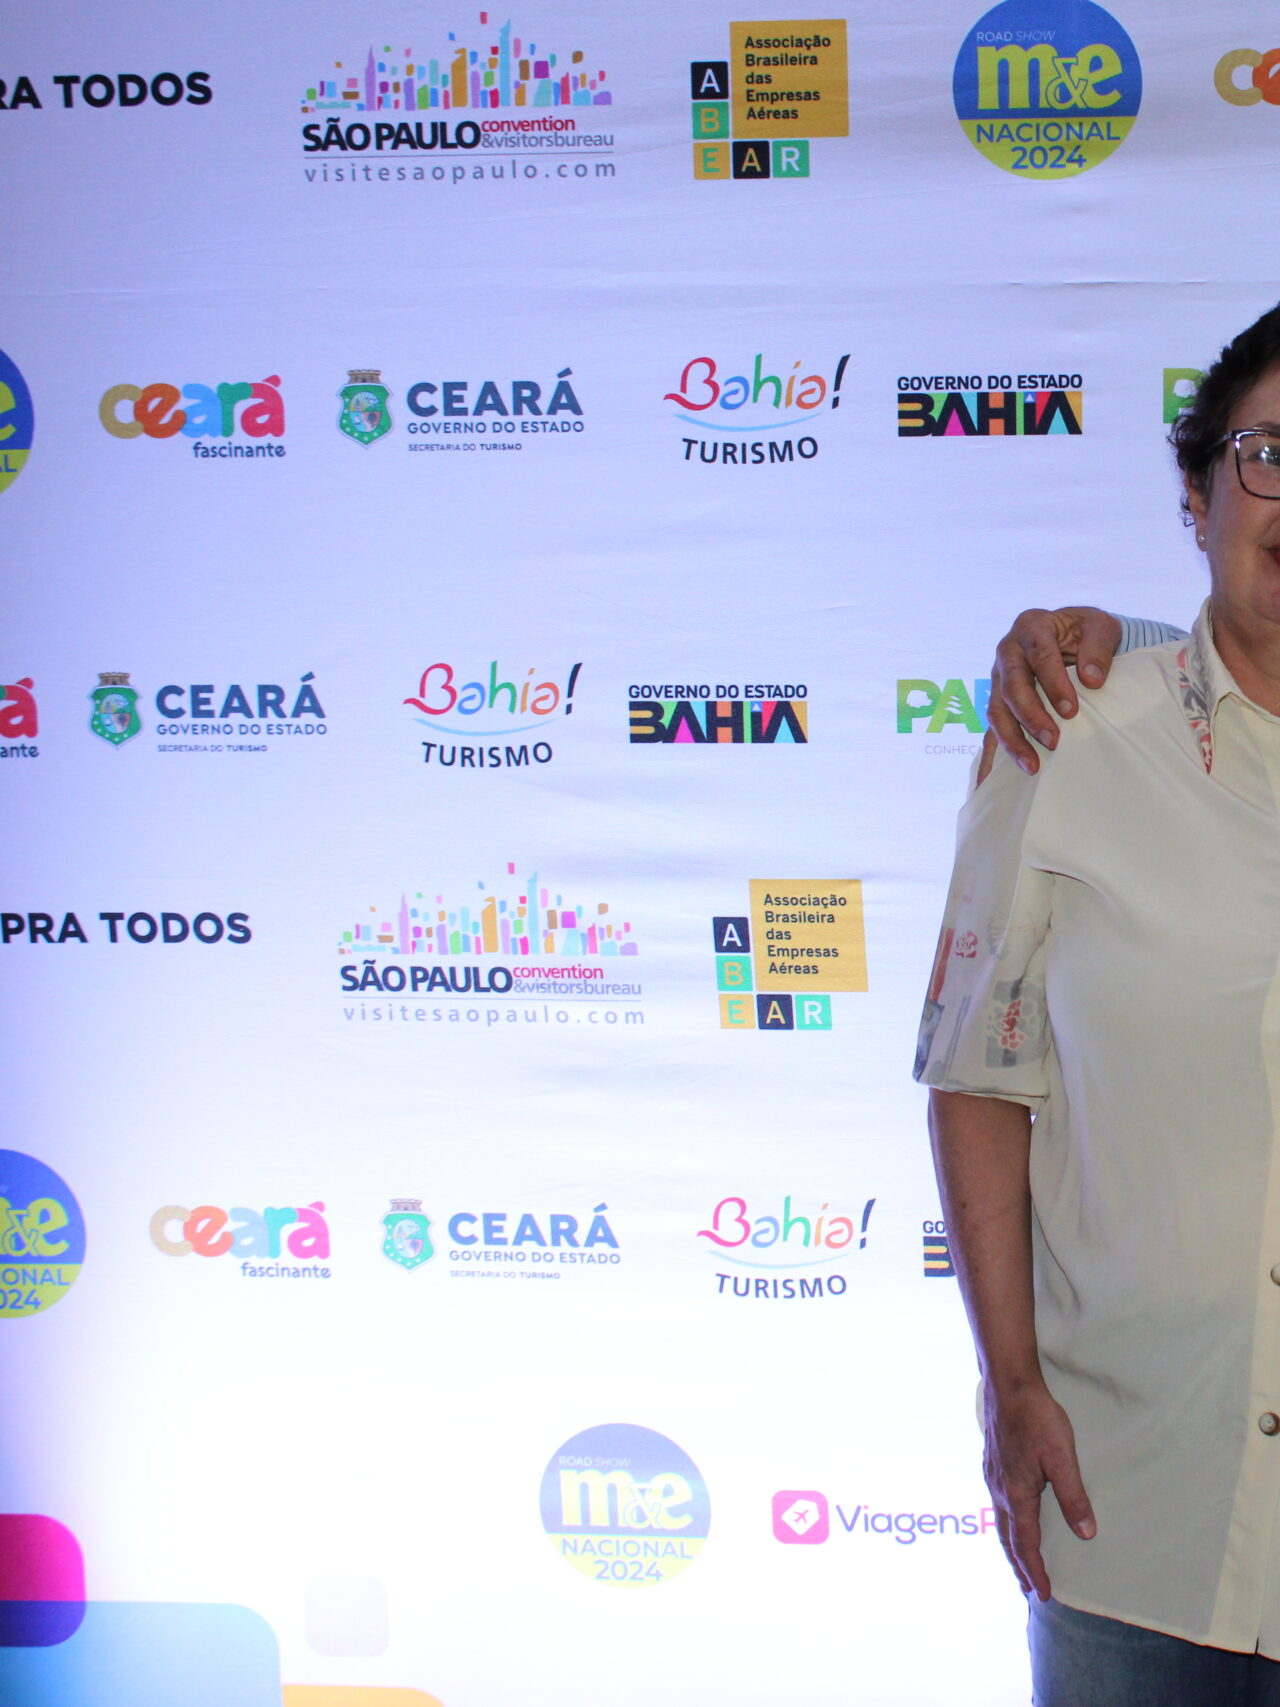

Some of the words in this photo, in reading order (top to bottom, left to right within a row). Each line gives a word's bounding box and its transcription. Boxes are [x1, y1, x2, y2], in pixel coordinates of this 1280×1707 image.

[745, 35, 831, 51] Associação
[977, 32, 1013, 41] ROAD
[1015, 30, 1056, 41] SHOW
[746, 52, 818, 66] Brasileira
[746, 71, 772, 84] das
[54, 73, 212, 108] TODOS
[746, 89, 820, 104] Empresas
[747, 107, 798, 120] Aéreas
[303, 118, 370, 151] SÃO
[376, 121, 481, 150] PAULO
[482, 116, 575, 133] convention
[976, 122, 1121, 143] NACIONAL
[1012, 146, 1087, 169] 2024
[305, 159, 616, 184] visitesaopaulo.com
[898, 376, 983, 391] GOVERNO
[988, 375, 1012, 389] DO
[1017, 374, 1083, 389] ESTADO
[407, 367, 583, 416] CEARÁ
[99, 375, 285, 438] ceará
[408, 423, 487, 434] GOVERNO
[492, 422, 516, 434] DO
[522, 422, 584, 433] ESTADO
[193, 442, 285, 458] fascinante
[463, 443, 476, 451] DO
[480, 443, 522, 451] TURISMO
[681, 437, 819, 465] TURISMO
[156, 671, 325, 718] CEARÁ
[628, 685, 710, 699] GOVERNO
[716, 685, 739, 698] DO
[745, 685, 808, 698] ESTADO
[157, 724, 233, 735] GOVERNO
[239, 724, 262, 734] DO
[267, 723, 327, 735] ESTADO
[227, 744, 267, 752] TURISMO
[422, 742, 553, 768] TURISMO
[764, 894, 847, 909] Associação
[765, 911, 835, 923] Brasileira
[0, 912, 89, 943] PRA
[101, 912, 252, 943] TODOS
[766, 928, 791, 940] das
[767, 945, 839, 960] Empresas
[340, 960, 405, 992] SÃO
[411, 965, 512, 993] PAULO
[513, 964, 604, 980] convention
[769, 962, 819, 974] Aéreas
[343, 1004, 645, 1026] visitesaopaulo.com
[0, 1198, 70, 1257] &e
[150, 1201, 330, 1259] ceará
[448, 1202, 620, 1249] CEARÁ
[449, 1250, 526, 1262] GOVERNO
[531, 1251, 554, 1263] DO
[559, 1252, 621, 1264] ESTADO
[241, 1262, 332, 1279] fascinante
[715, 1273, 847, 1299] TURISMO
[559, 1456, 592, 1466] ROAD
[561, 1538, 693, 1558] NACIONAL
[594, 1560, 664, 1581] 2024
